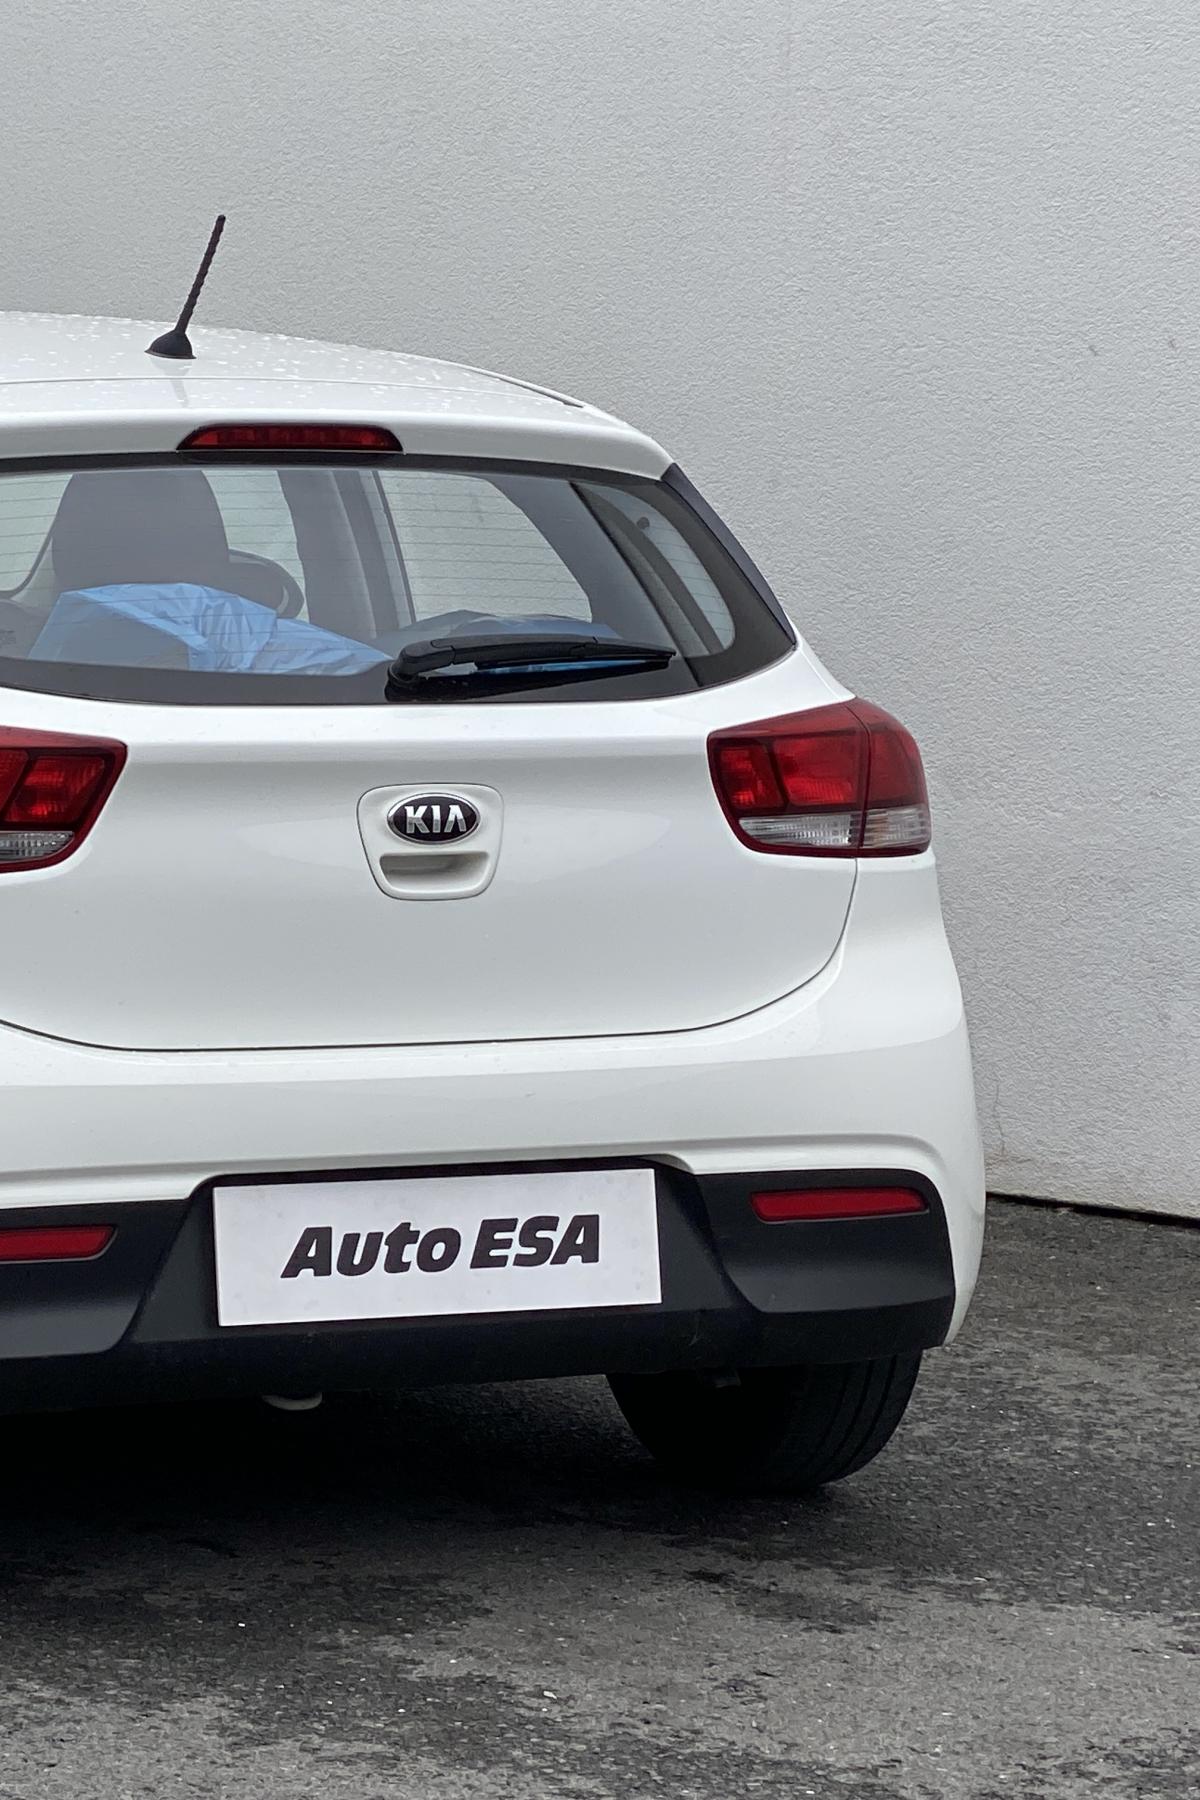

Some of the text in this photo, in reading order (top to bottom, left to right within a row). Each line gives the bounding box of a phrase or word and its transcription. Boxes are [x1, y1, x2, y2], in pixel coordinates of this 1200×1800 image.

[404, 804, 467, 834] KIA
[280, 1214, 600, 1279] Auto ESA
